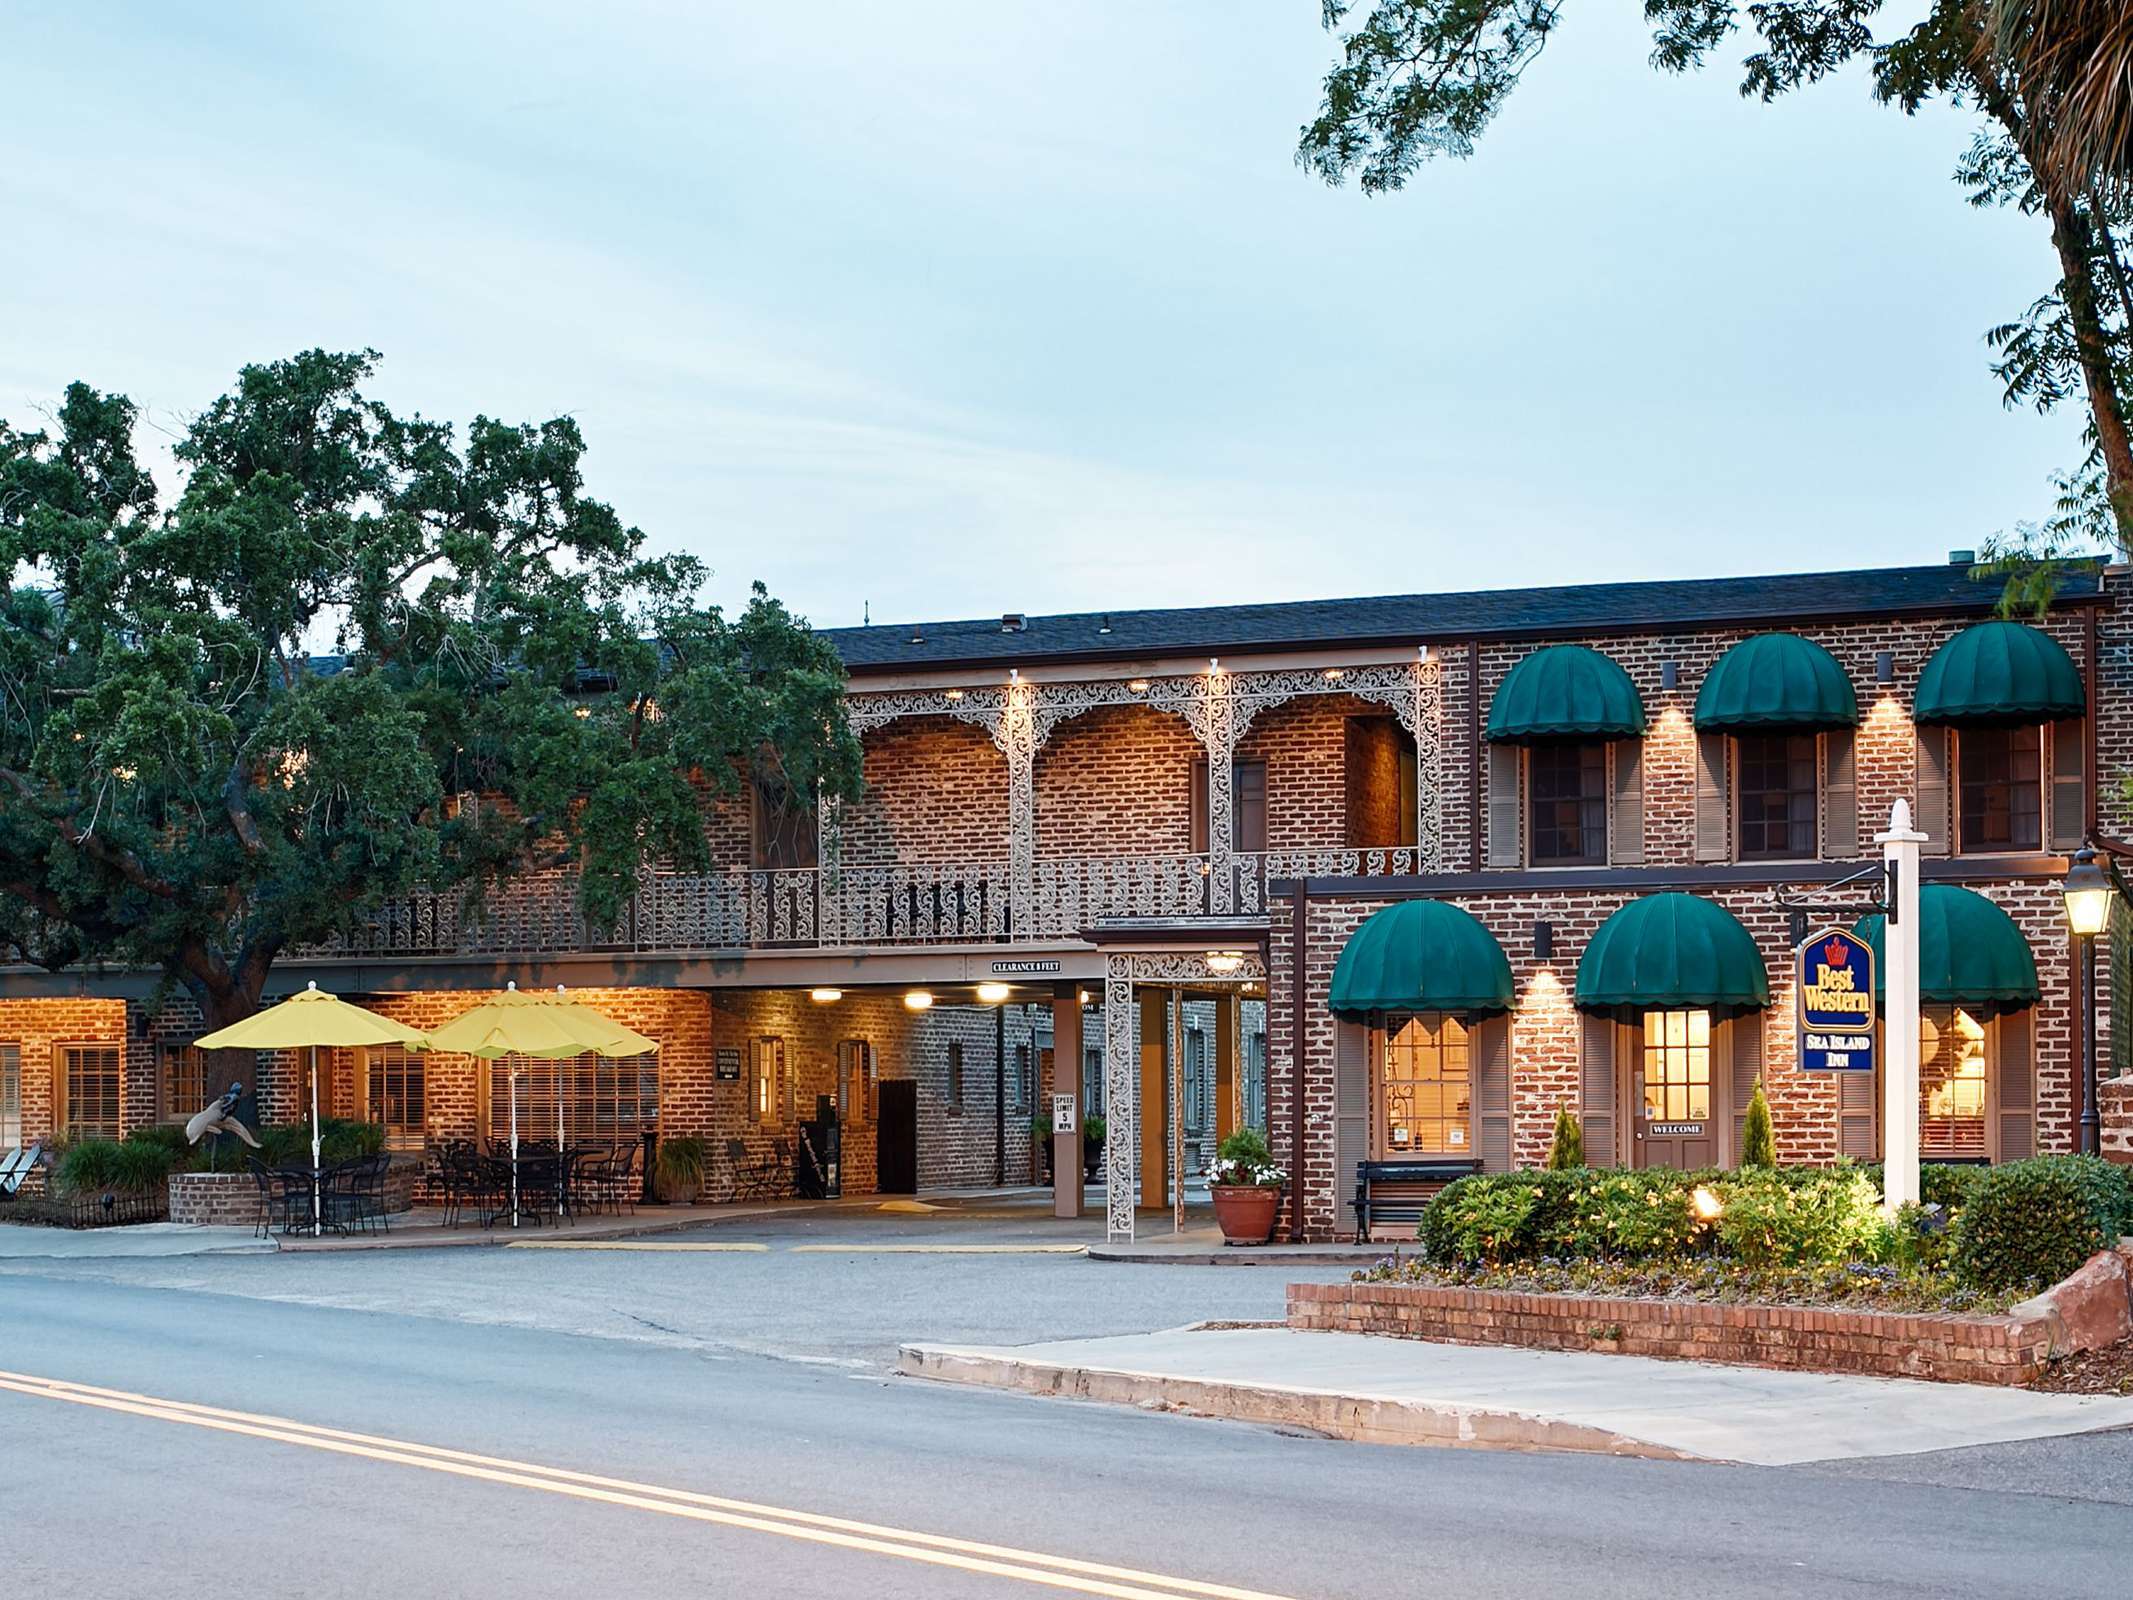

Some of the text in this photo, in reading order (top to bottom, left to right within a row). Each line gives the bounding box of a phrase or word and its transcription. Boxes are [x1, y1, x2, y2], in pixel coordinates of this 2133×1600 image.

[993, 962, 1035, 972] CLEARANCE
[1041, 961, 1059, 971] FEET
[1816, 963, 1855, 991] Best
[1803, 984, 1870, 1013] Western
[1806, 1034, 1870, 1050] SEA ISLAND
[1826, 1052, 1849, 1067] INN
[1055, 1096, 1074, 1104] SPEED
[1056, 1104, 1073, 1112] LIMIT
[1062, 1113, 1068, 1122] 5
[1058, 1122, 1072, 1130] MPH
[1653, 1125, 1700, 1133] WELCOME
